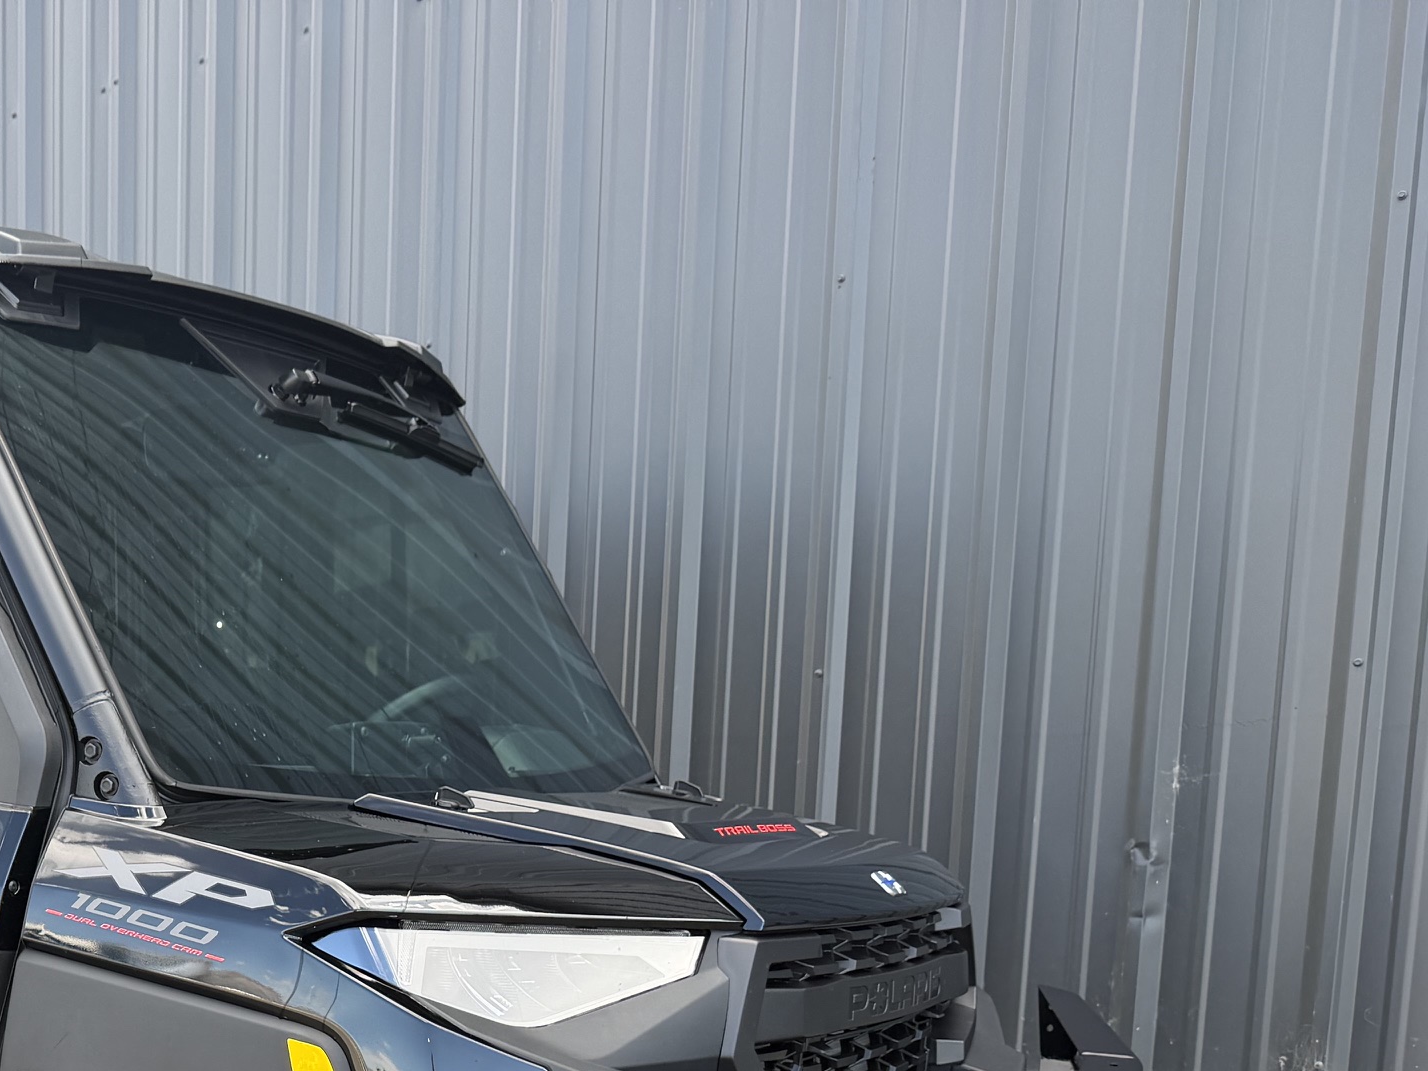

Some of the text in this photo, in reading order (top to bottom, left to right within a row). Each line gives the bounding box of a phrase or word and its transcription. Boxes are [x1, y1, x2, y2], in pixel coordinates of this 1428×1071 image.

[53, 846, 276, 909] XP
[64, 913, 203, 957] DUAL OVERHEAD CAM
[71, 893, 219, 945] 1000
[849, 966, 942, 1021] POLARIS
